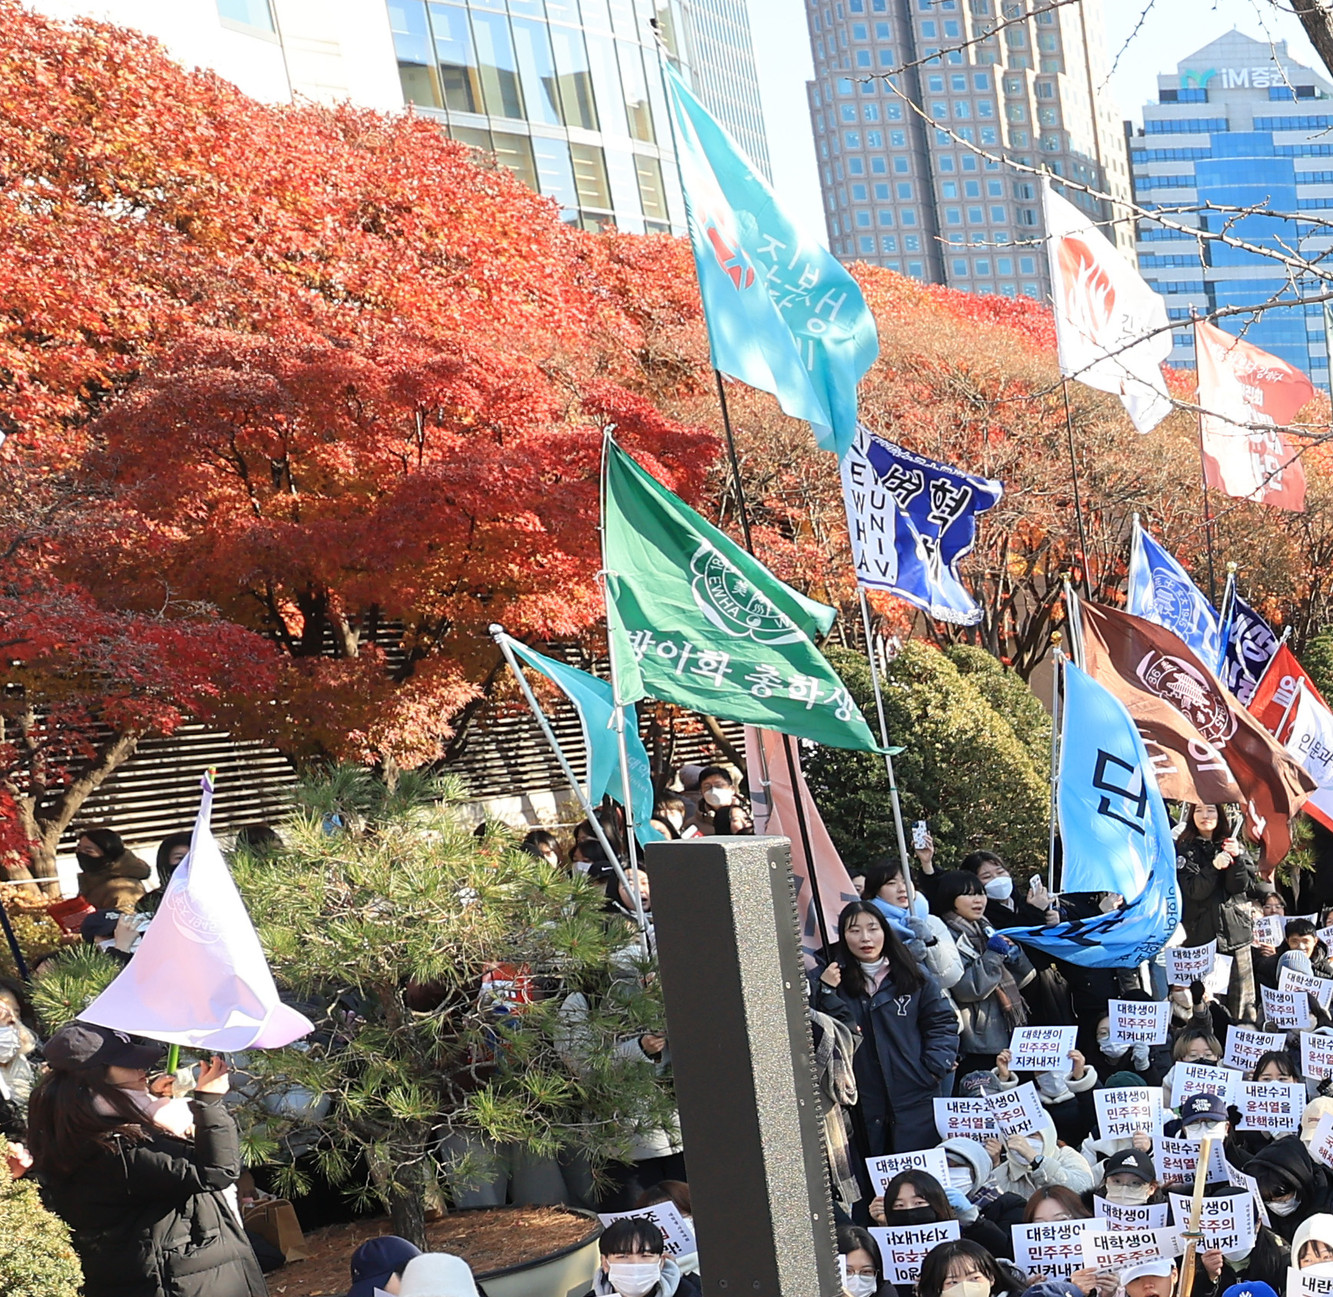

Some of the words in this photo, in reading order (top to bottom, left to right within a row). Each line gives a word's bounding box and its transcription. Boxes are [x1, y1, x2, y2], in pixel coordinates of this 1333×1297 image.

[851, 461, 871, 574] EWHA
[868, 490, 895, 580] UNIV.
[708, 575, 739, 618] EWHA
[893, 995, 910, 1017] Y
[1020, 1026, 1063, 1041] 대학생이
